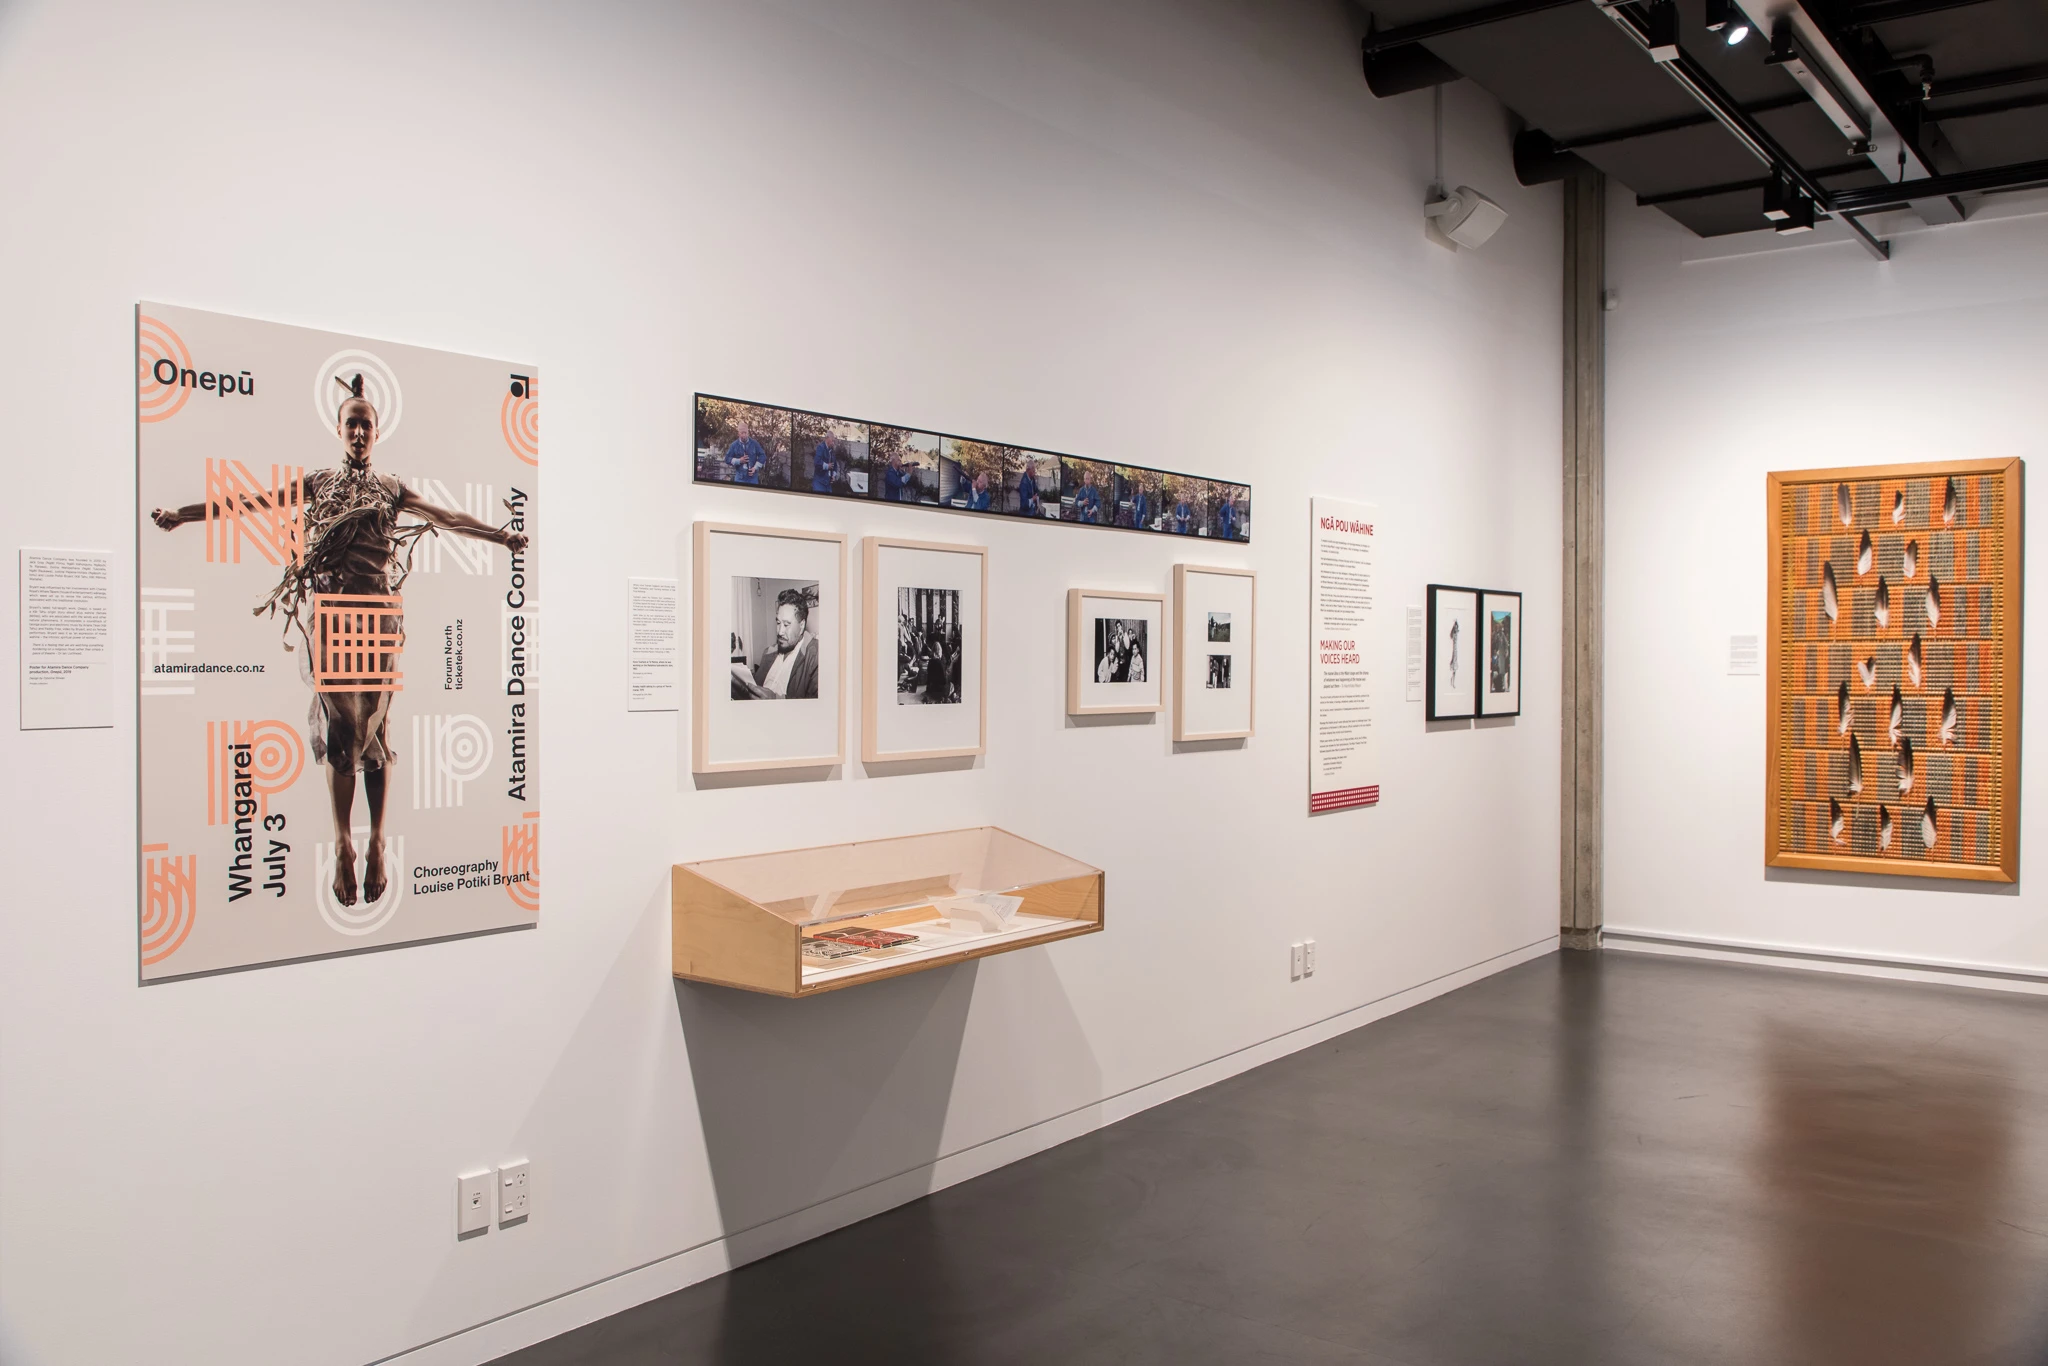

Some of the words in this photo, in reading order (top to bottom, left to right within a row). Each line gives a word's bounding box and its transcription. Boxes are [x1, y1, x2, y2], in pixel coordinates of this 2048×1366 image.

[154, 358, 254, 397] Onepū
[1320, 516, 1334, 530] NGĀ
[1336, 520, 1348, 532] POU
[1350, 520, 1373, 536] WĀHINE
[506, 487, 528, 609] Comany
[444, 625, 452, 655] North
[455, 618, 463, 690] ticketek.co.nz
[507, 615, 525, 696] Dance
[1320, 640, 1342, 650] MAKING
[1343, 640, 1355, 650] OUR
[154, 663, 265, 673] atamiradance.co.nz
[444, 656, 452, 690] Forum
[1320, 654, 1340, 664] VOICES
[1341, 654, 1360, 664] HEARD
[508, 702, 526, 801] Atamira
[228, 744, 257, 902] Whangarei
[263, 813, 286, 832] 3
[263, 839, 290, 898] July
[413, 859, 499, 878] Choreography
[413, 881, 454, 895] Louise
[457, 875, 490, 889] Potiki
[493, 871, 530, 886] Bryant
